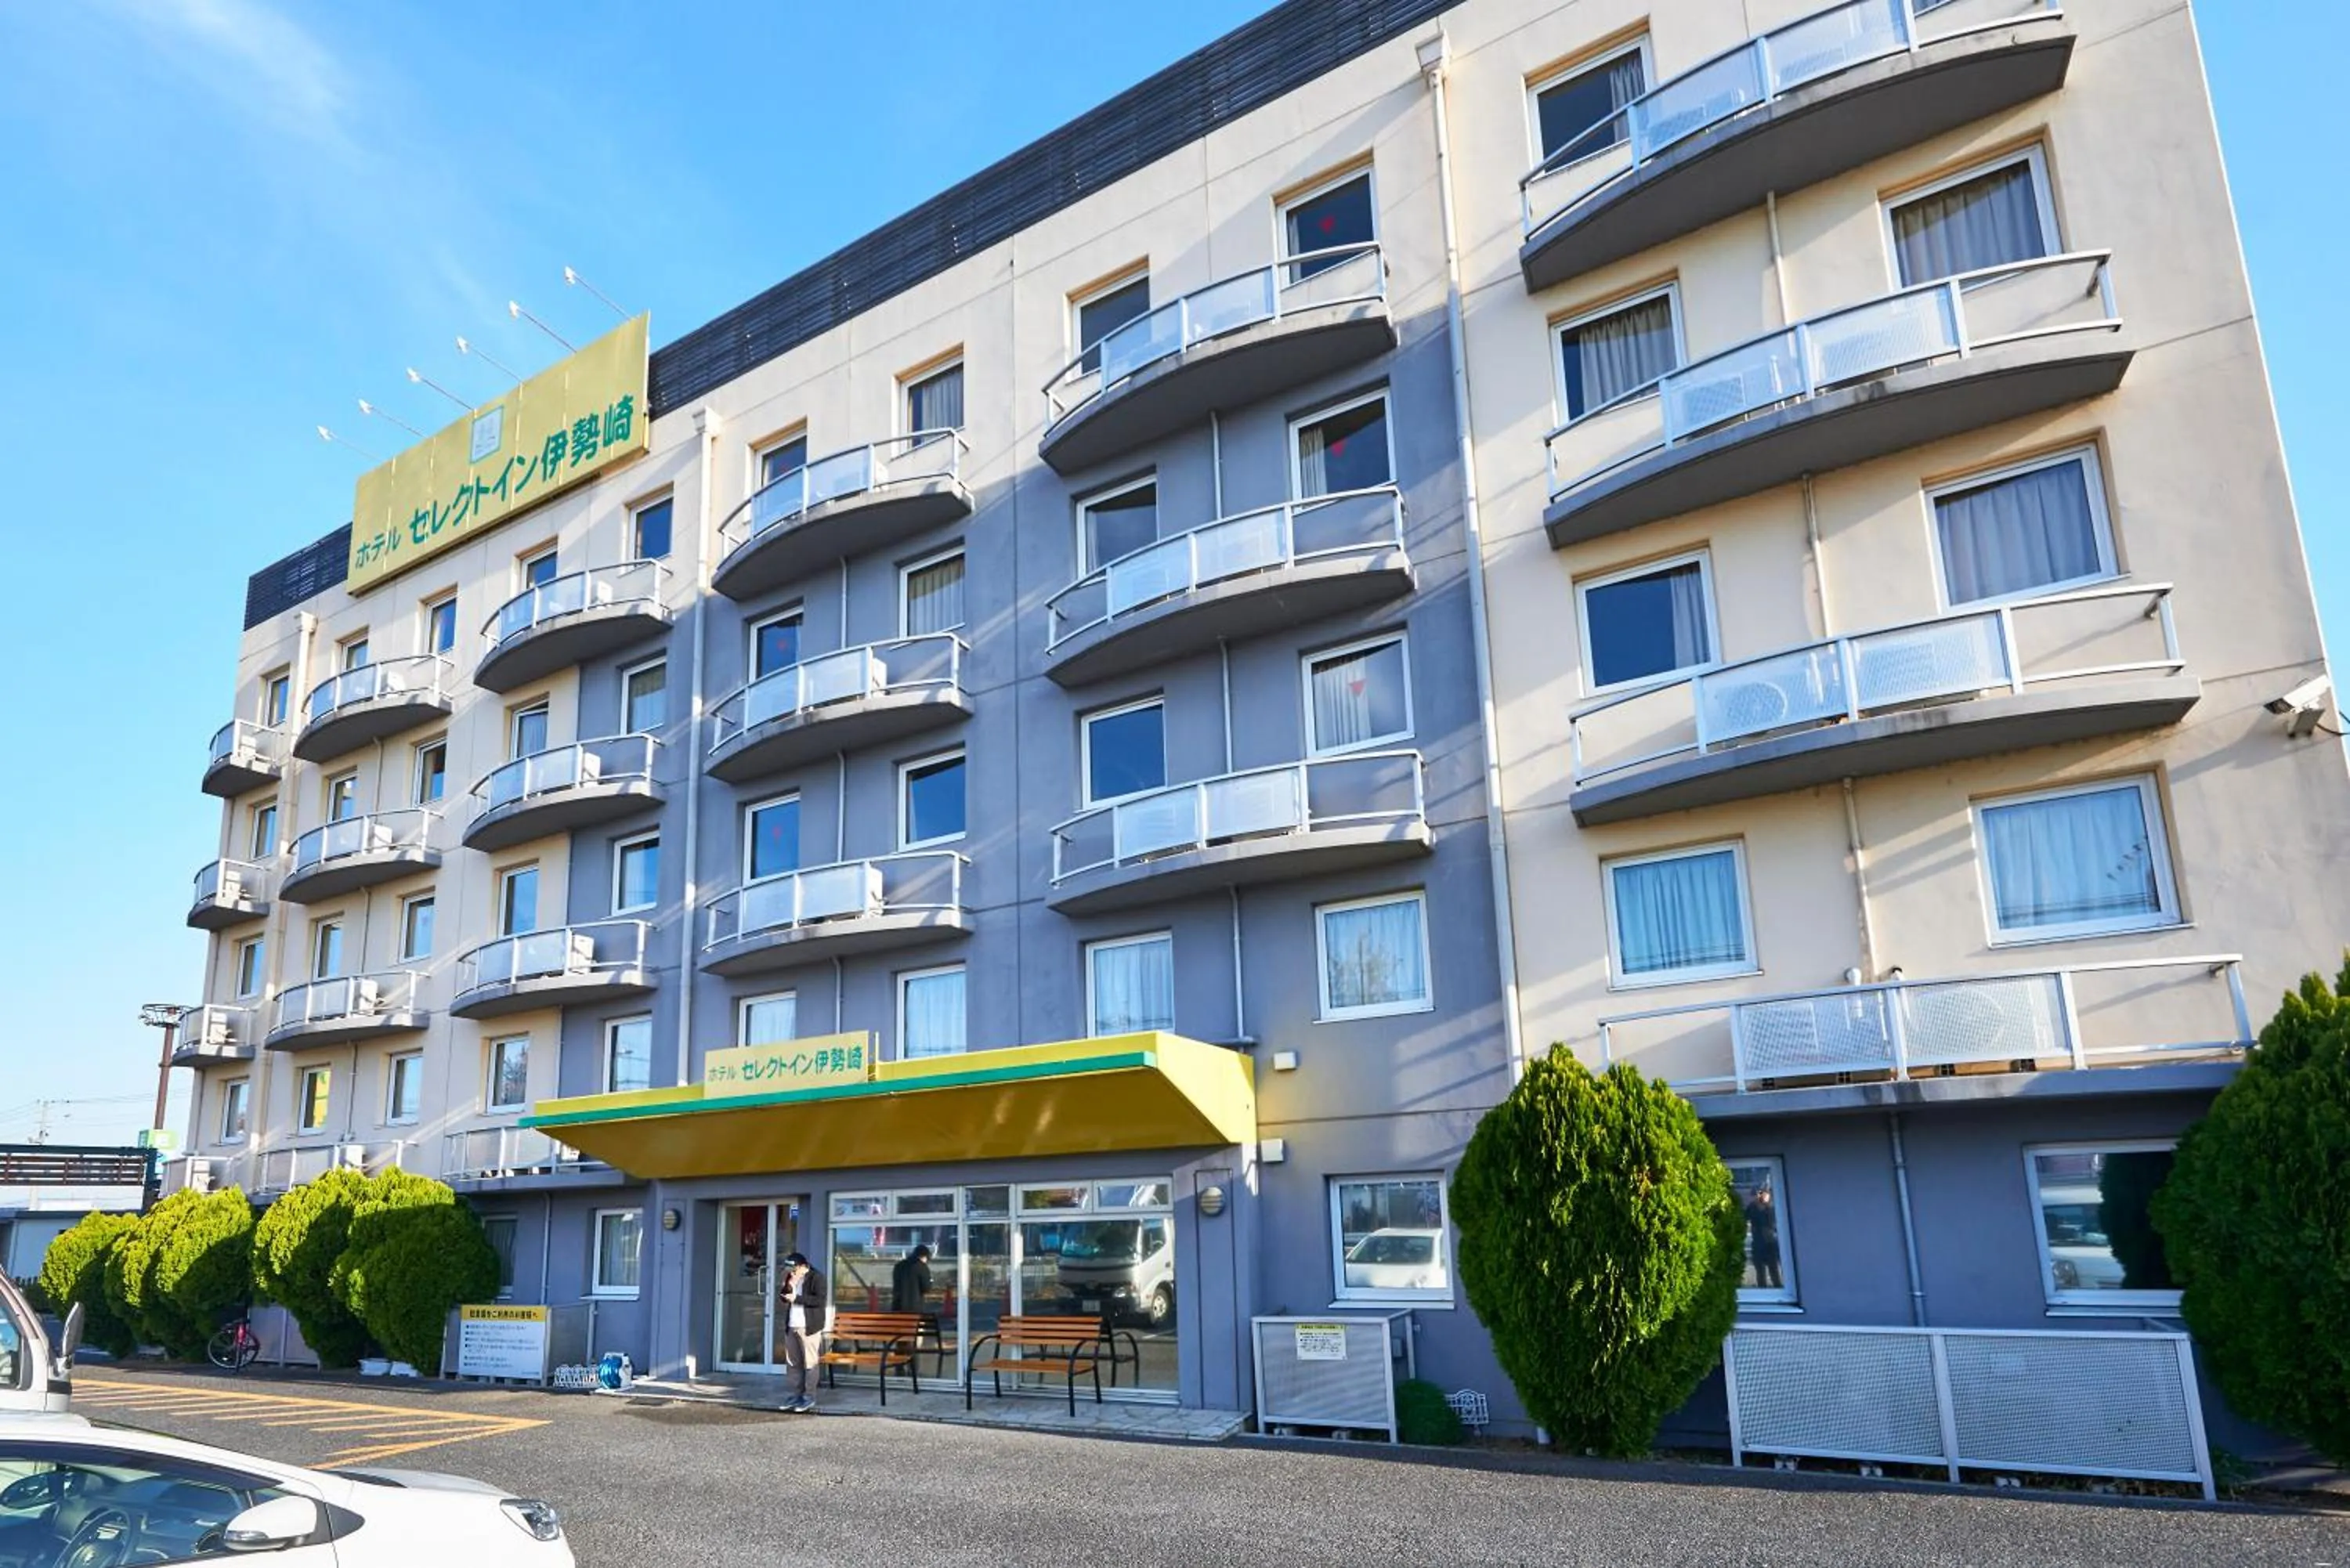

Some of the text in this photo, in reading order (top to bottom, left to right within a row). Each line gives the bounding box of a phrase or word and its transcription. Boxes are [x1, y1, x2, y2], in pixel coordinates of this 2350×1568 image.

[355, 395, 634, 569] ホテル セレクトイン伊勢崎
[708, 1044, 862, 1082] ホテル セレクトイン伊勢崎
